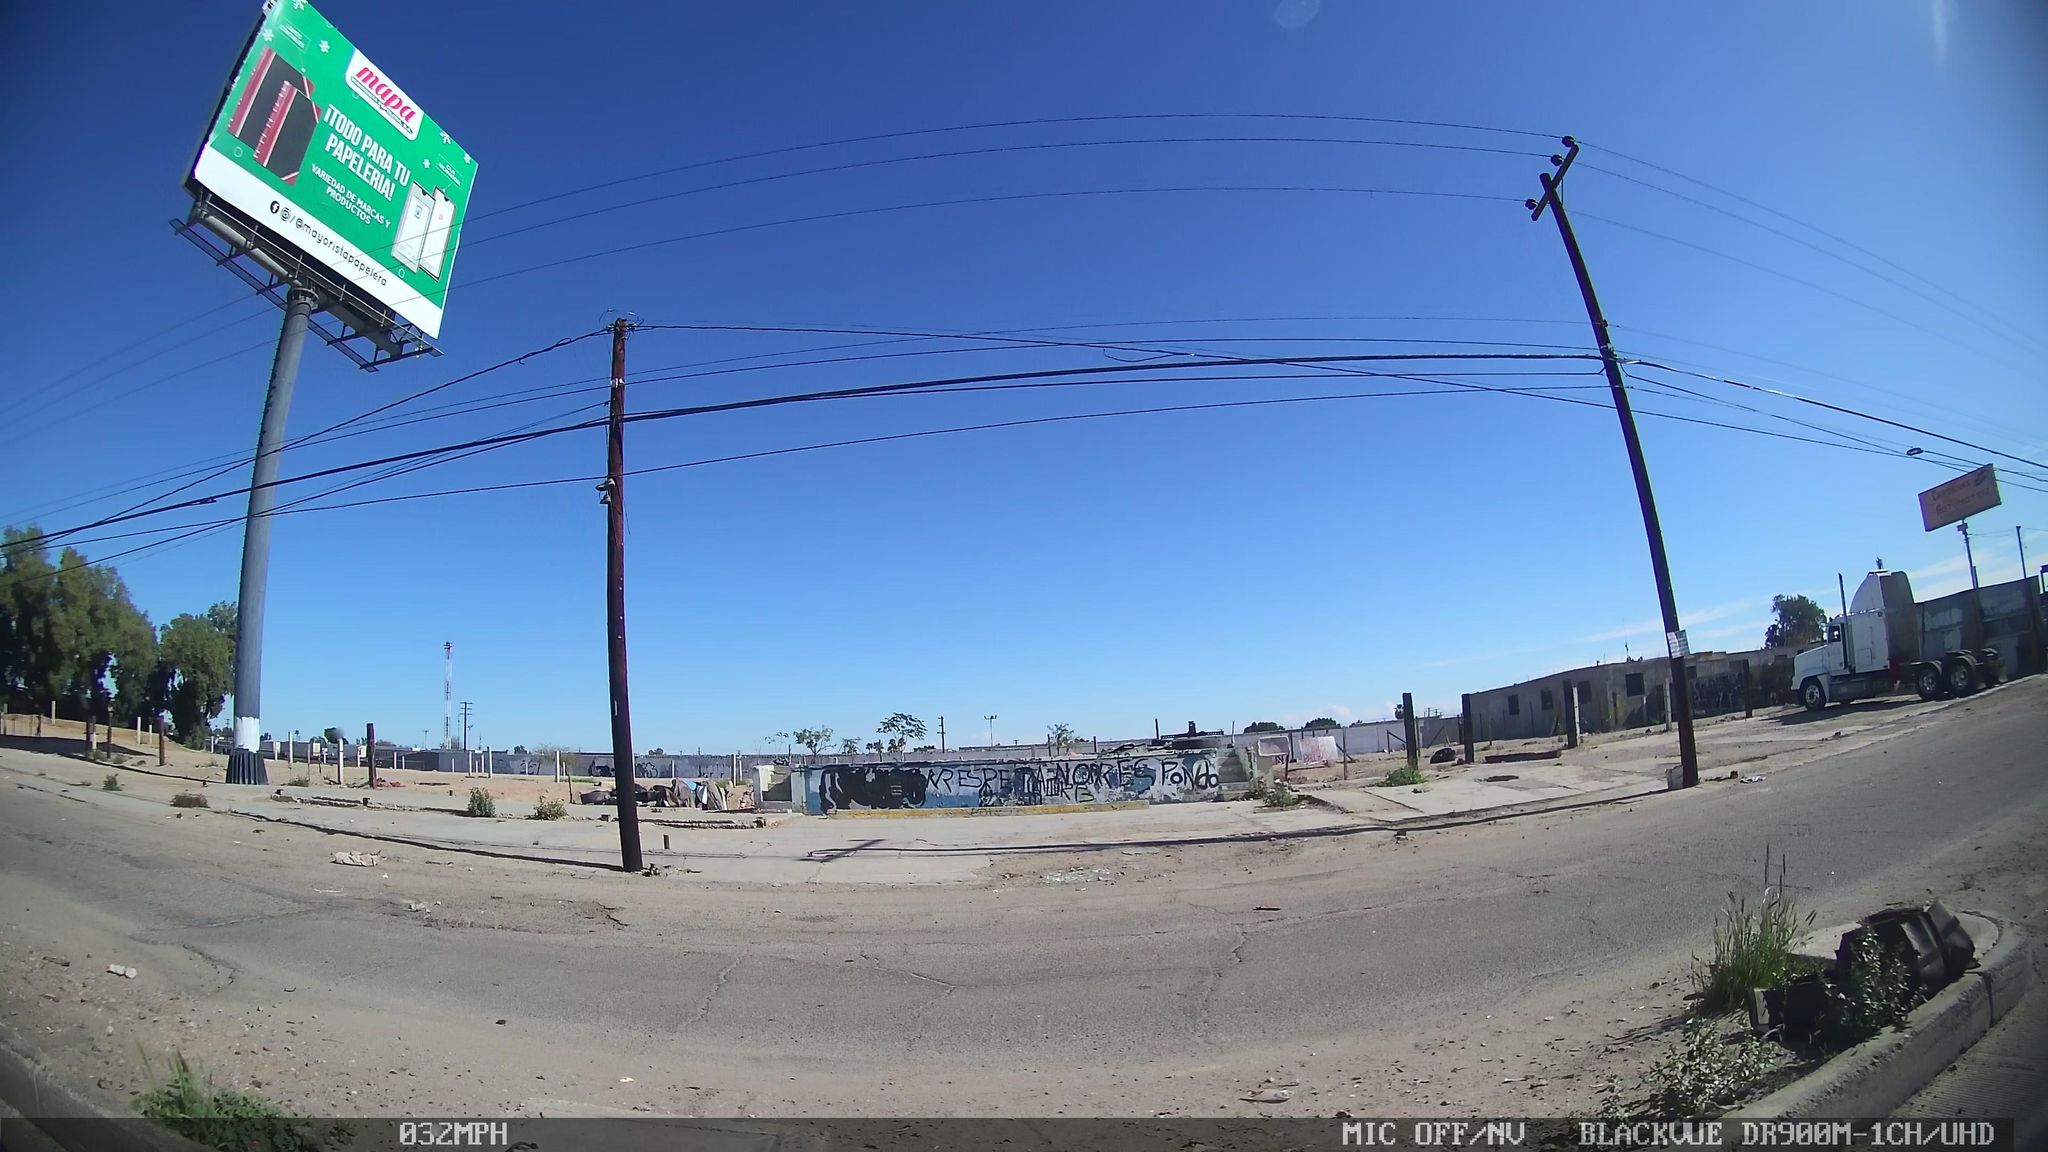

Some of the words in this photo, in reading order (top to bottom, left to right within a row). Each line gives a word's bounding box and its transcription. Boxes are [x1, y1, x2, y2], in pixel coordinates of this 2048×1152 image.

[355, 67, 417, 123] mapa
[325, 132, 396, 202] PAPELERIA!
[361, 134, 394, 175] PARA
[394, 160, 411, 187] TU
[311, 163, 346, 194] VARIEDAD
[345, 190, 357, 203] DE
[356, 198, 385, 225] MARCAS
[384, 219, 392, 229] Y
[326, 186, 372, 225] PRODUCTOS
